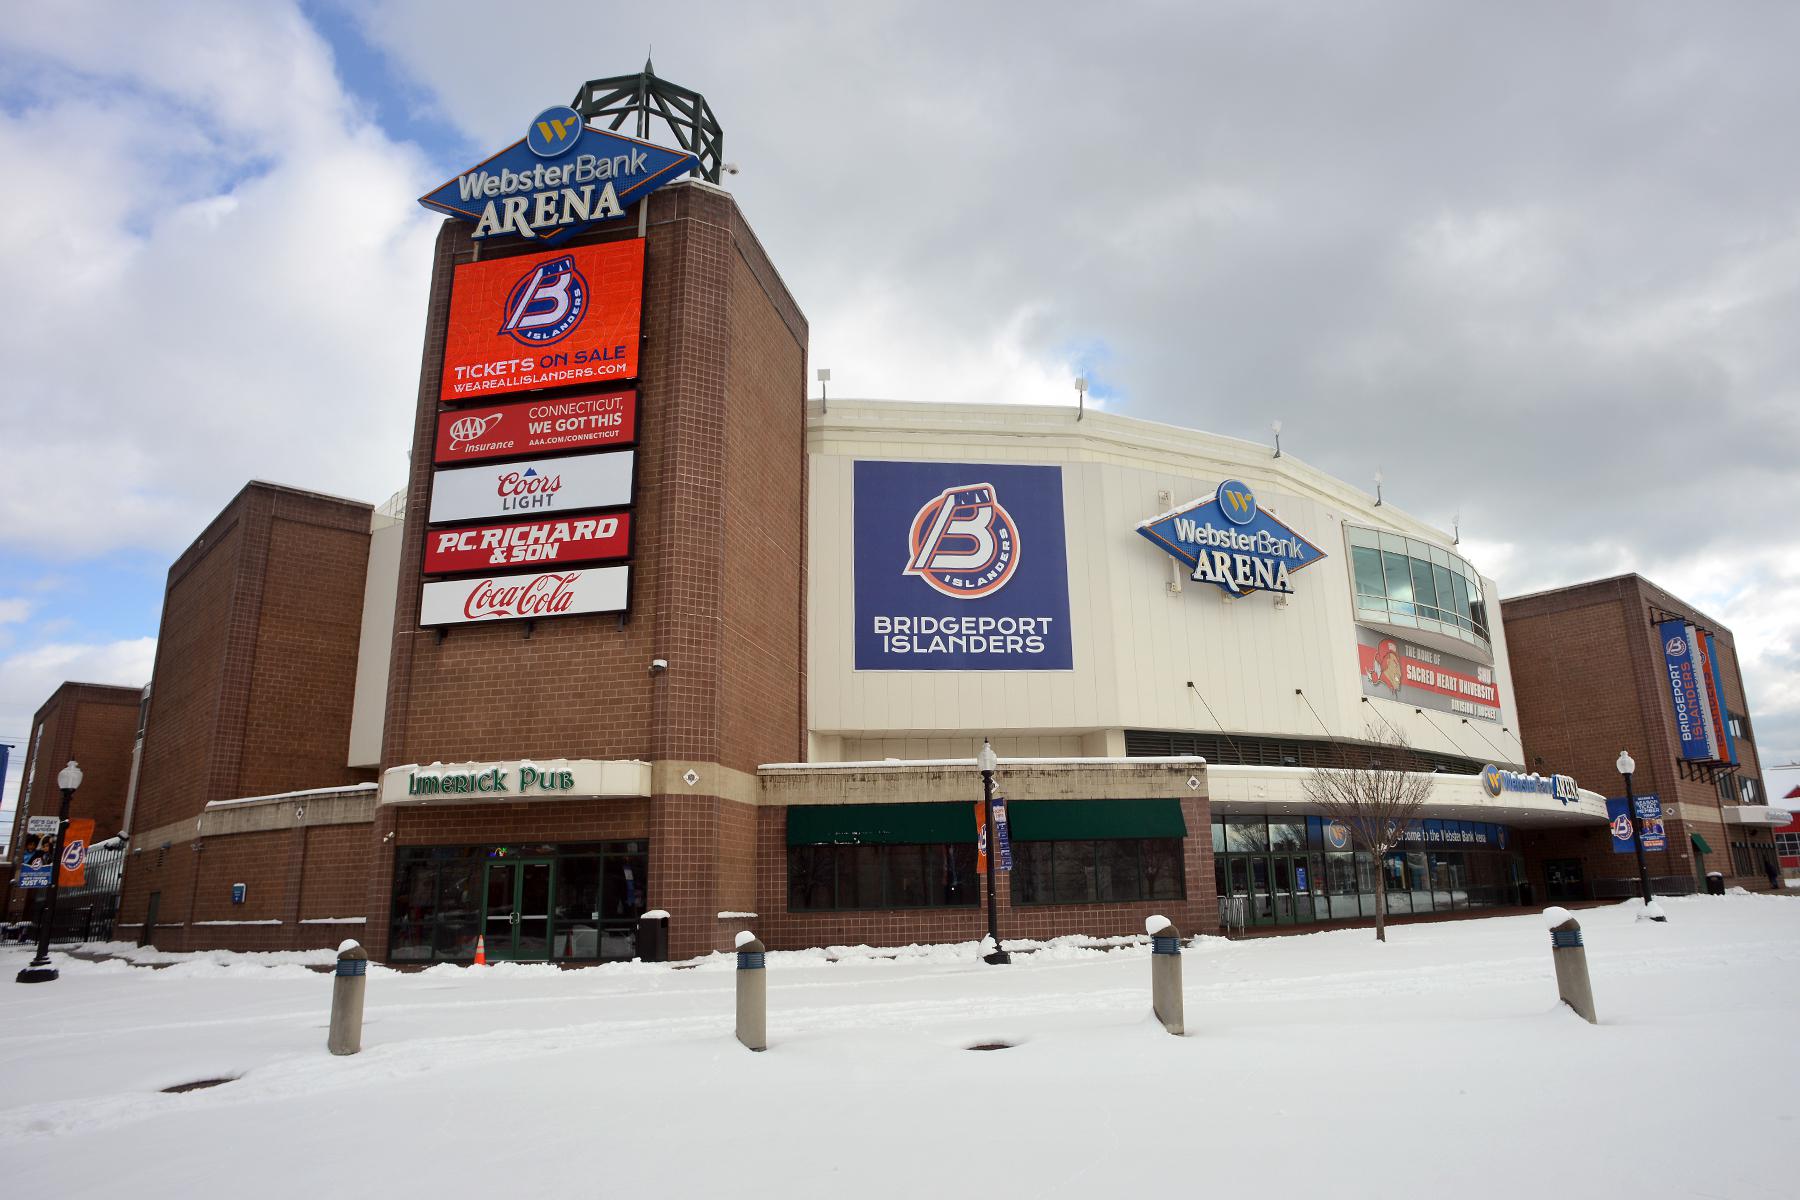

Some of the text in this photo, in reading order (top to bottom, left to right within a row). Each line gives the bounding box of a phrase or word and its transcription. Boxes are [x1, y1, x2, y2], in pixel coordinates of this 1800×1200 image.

[471, 181, 625, 239] ARENA
[526, 288, 582, 339] ISLANDERS
[455, 345, 627, 380] TICKETS ON SALE
[453, 363, 627, 393] WEAREALLISLANDERS.COM
[529, 397, 624, 419] CONNECTICUT,
[453, 417, 484, 440] AAA
[528, 412, 622, 434] WE GOT THIS
[465, 440, 514, 453] Insurance
[528, 430, 620, 446] AAA.COM/CONNECTICUT
[497, 472, 562, 497] Coors
[503, 494, 554, 511] LIGHT
[436, 518, 619, 553] P.C. RICHARD
[489, 543, 560, 564] & SON
[943, 528, 1011, 588] ISLANDERS
[1192, 549, 1293, 592] ARENA
[463, 571, 583, 619] Coca-Cola
[874, 616, 1053, 635] BRIDGEPORT
[883, 635, 1045, 653] ISLANDERS
[1406, 664, 1496, 701] SACRED HEART UNIVERSITY
[1668, 663, 1692, 741] BRIDGEPORT
[1681, 661, 1704, 740] ISLANDERS
[1430, 829, 1440, 841] the
[1461, 830, 1474, 842] Bank
